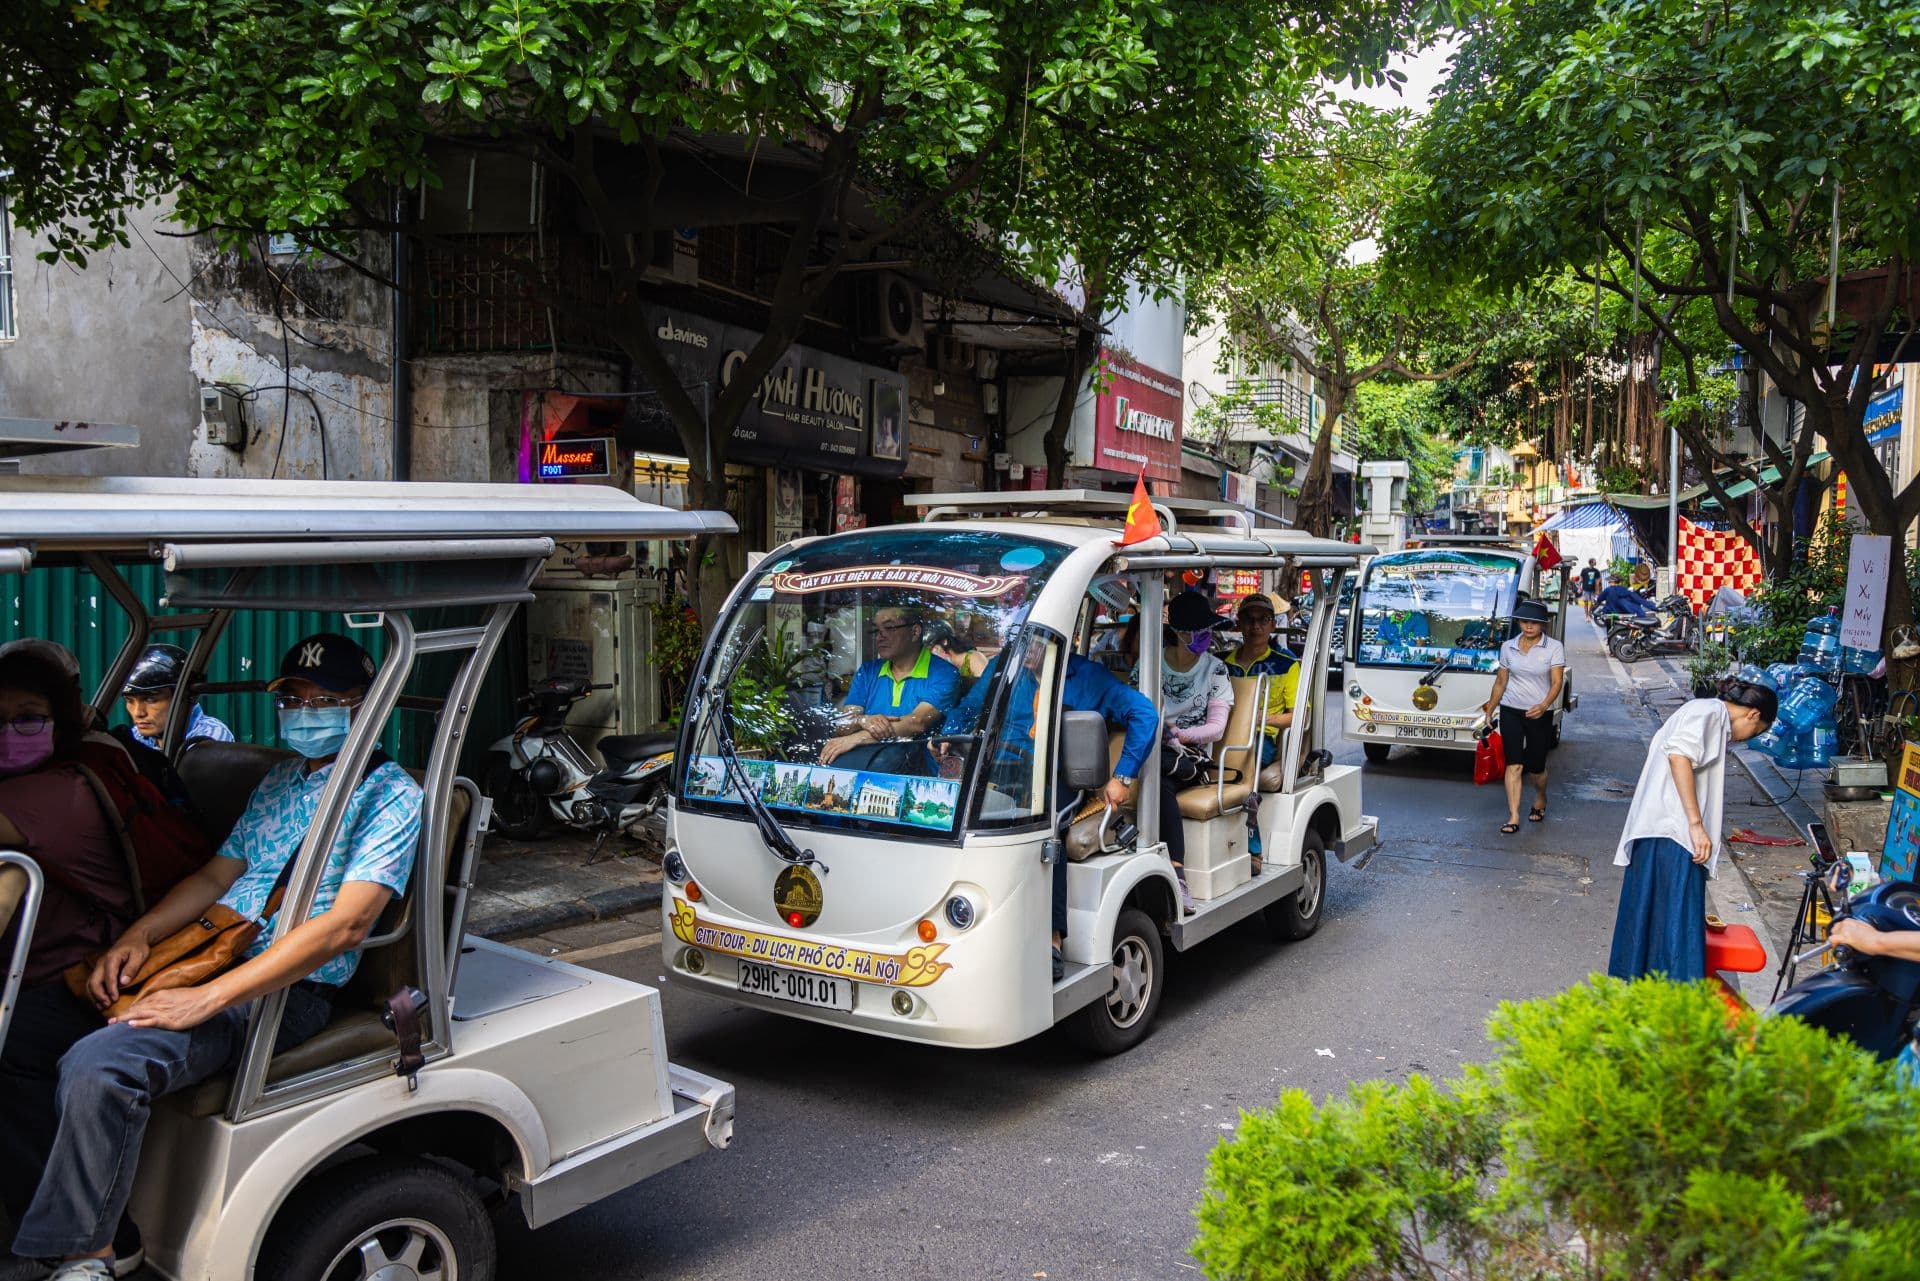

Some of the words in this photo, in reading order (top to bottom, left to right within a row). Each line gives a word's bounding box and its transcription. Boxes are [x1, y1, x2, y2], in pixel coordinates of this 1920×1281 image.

[658, 316, 708, 348] davines
[785, 410, 800, 423] HAIR
[801, 414, 825, 427] BEAUTY
[826, 418, 845, 431] SALON
[543, 465, 562, 475] FOOT
[833, 573, 847, 583] XE
[298, 642, 325, 667] NY
[1398, 726, 1449, 739] 29HC-001.03
[695, 927, 717, 943] CITY
[718, 930, 745, 949] TOUR
[753, 939, 768, 955] DU
[770, 941, 795, 961] LỊCH
[797, 943, 826, 965] PHỐ
[826, 948, 848, 970] CỔ
[854, 957, 873, 976] HÀ
[875, 962, 900, 984] NỘI
[742, 963, 837, 1005] 29HC-001.01
